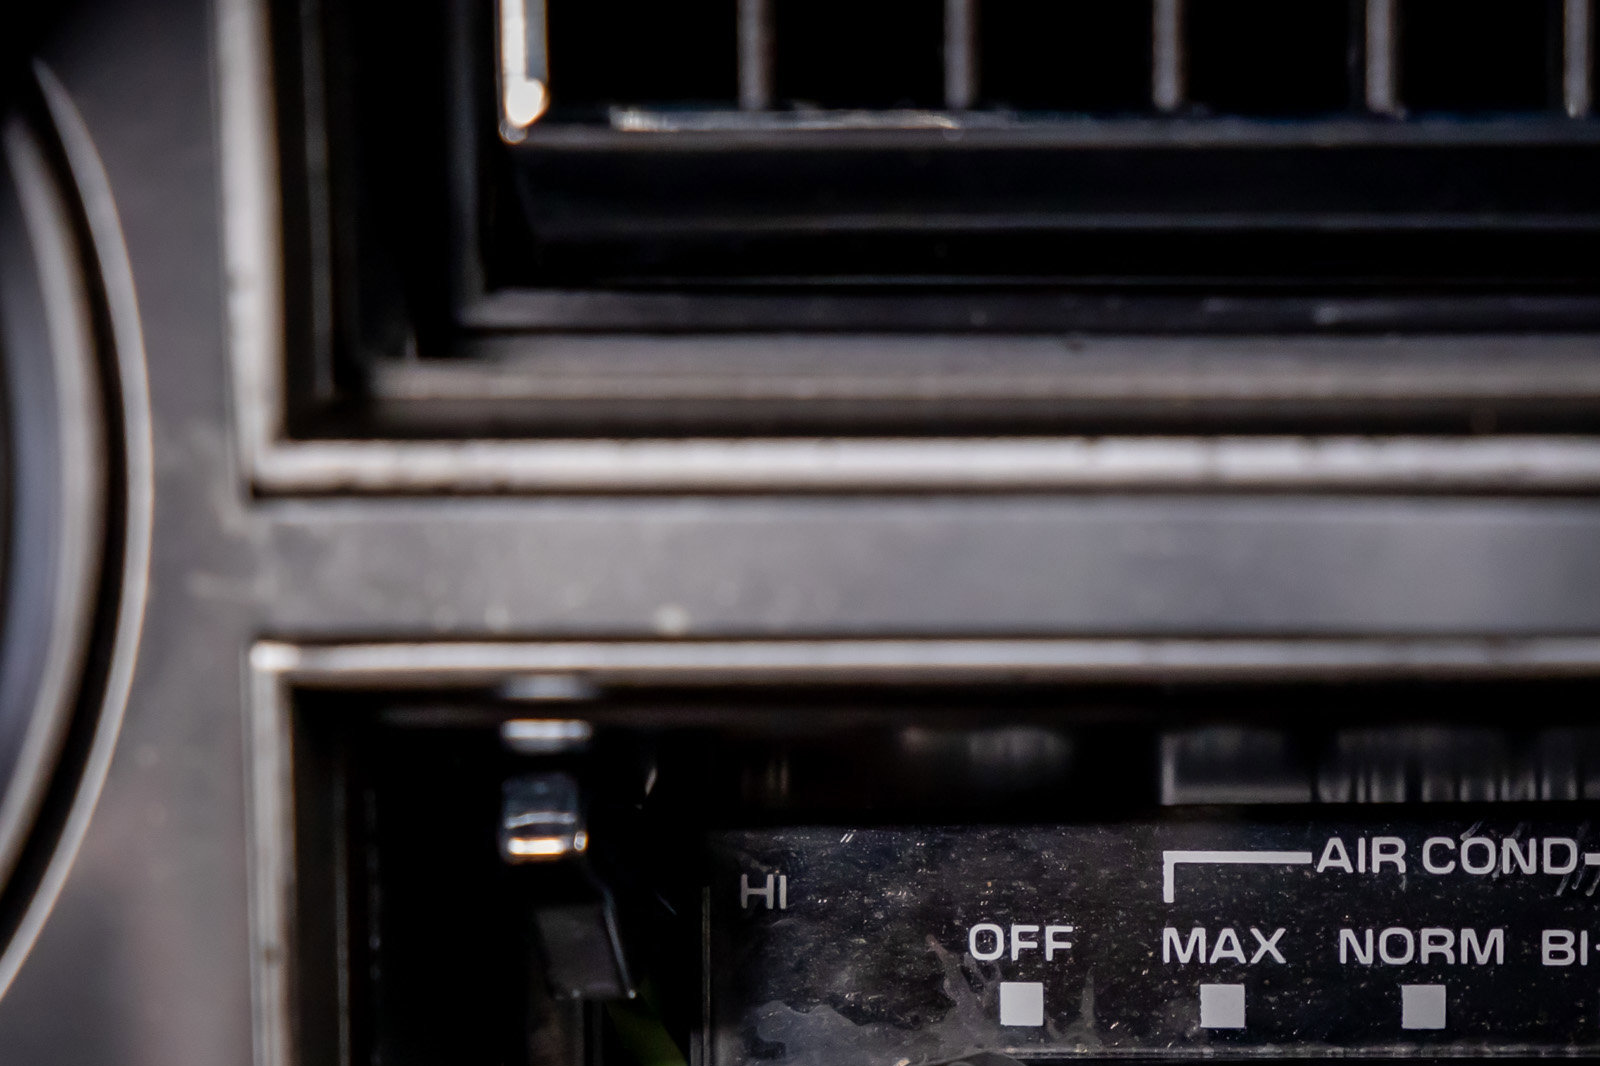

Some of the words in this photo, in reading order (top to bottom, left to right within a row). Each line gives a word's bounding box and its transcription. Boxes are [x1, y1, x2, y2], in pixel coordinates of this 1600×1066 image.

[1315, 836, 1407, 875] AIR
[1421, 835, 1579, 876] COND
[739, 873, 788, 910] HI
[967, 921, 1075, 963] OFF
[1161, 926, 1288, 965] MAX
[1338, 926, 1505, 966] NORM
